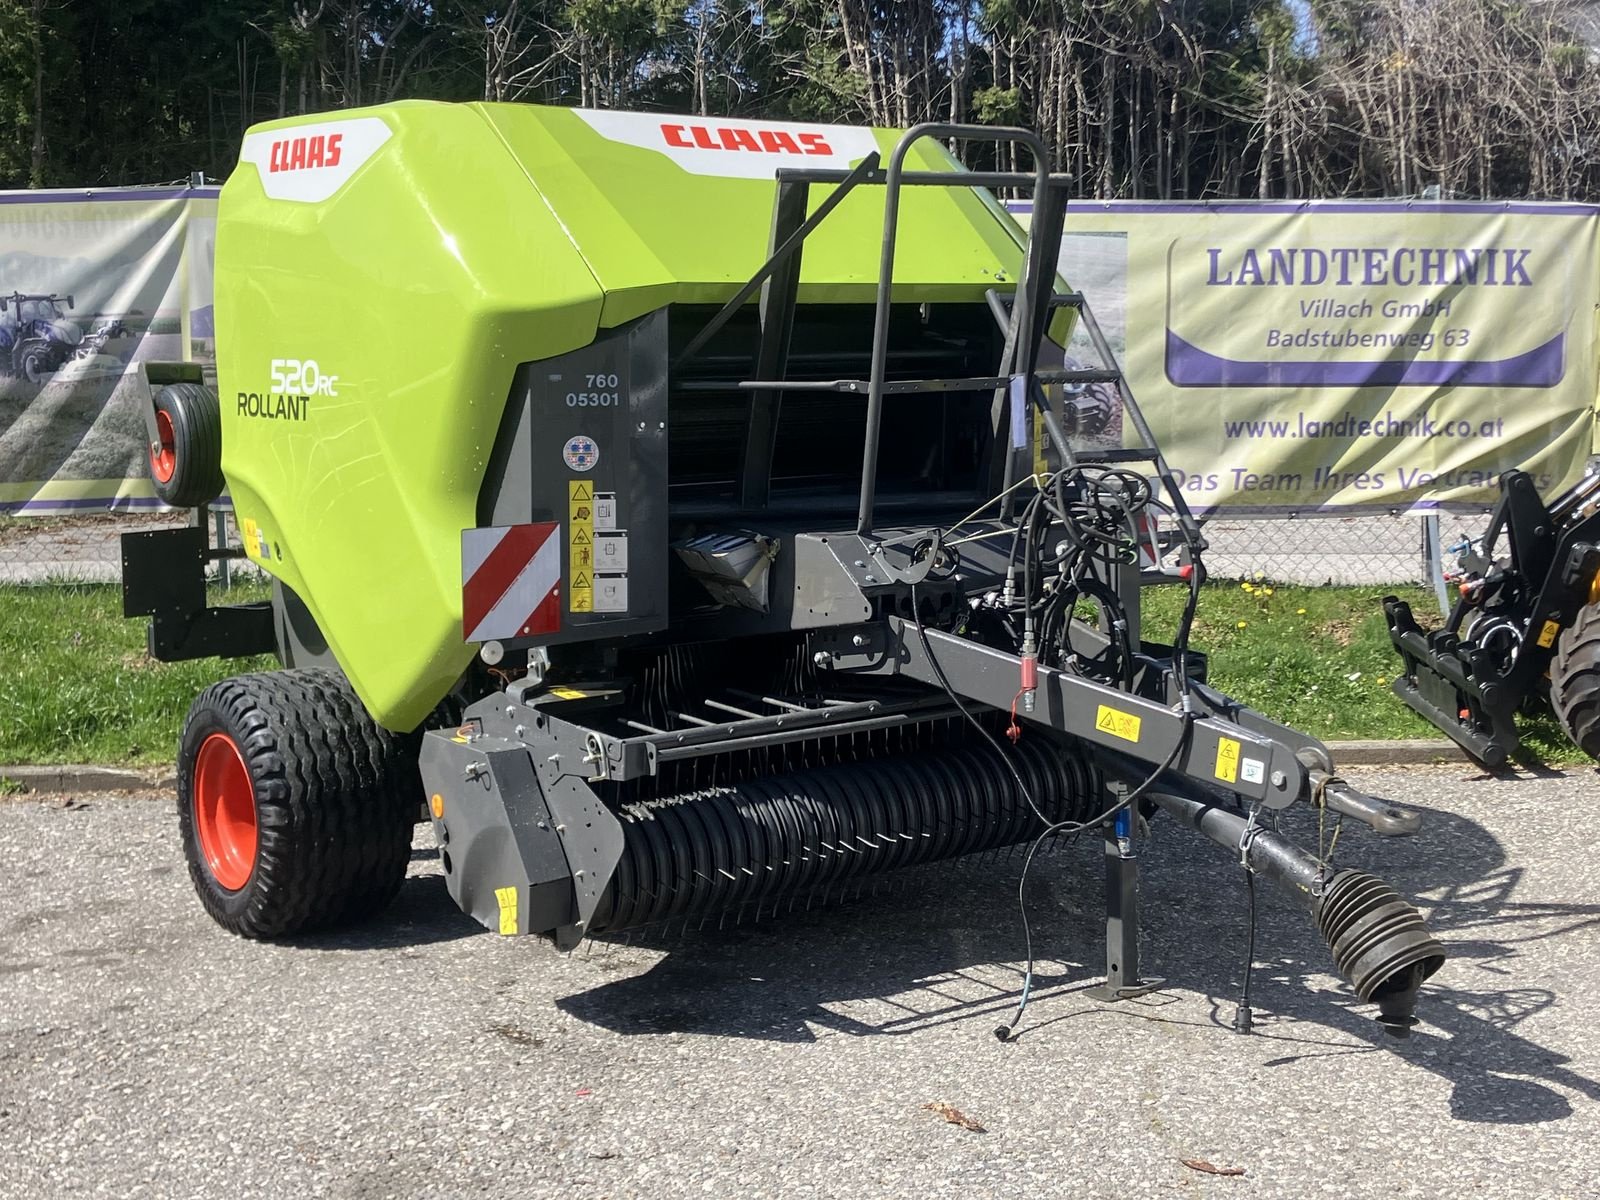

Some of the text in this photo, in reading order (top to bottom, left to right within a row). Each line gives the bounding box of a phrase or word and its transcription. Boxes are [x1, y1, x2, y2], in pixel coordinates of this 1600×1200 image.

[269, 133, 343, 173] CLAAS
[660, 124, 833, 156] CLAAS
[1206, 247, 1533, 287] LANDTECHNIK
[1300, 299, 1452, 319] Villach GmbH
[1266, 328, 1471, 350] Badstubenweg 63
[585, 374, 619, 388] 760
[237, 391, 311, 422] ROLLANT
[566, 393, 619, 407] 05301
[1224, 410, 1505, 440] www.landtechnik.co.at
[1230, 468, 1303, 492] Team
[1313, 466, 1384, 491] Ihres
[1398, 467, 1552, 491] Vertraus
